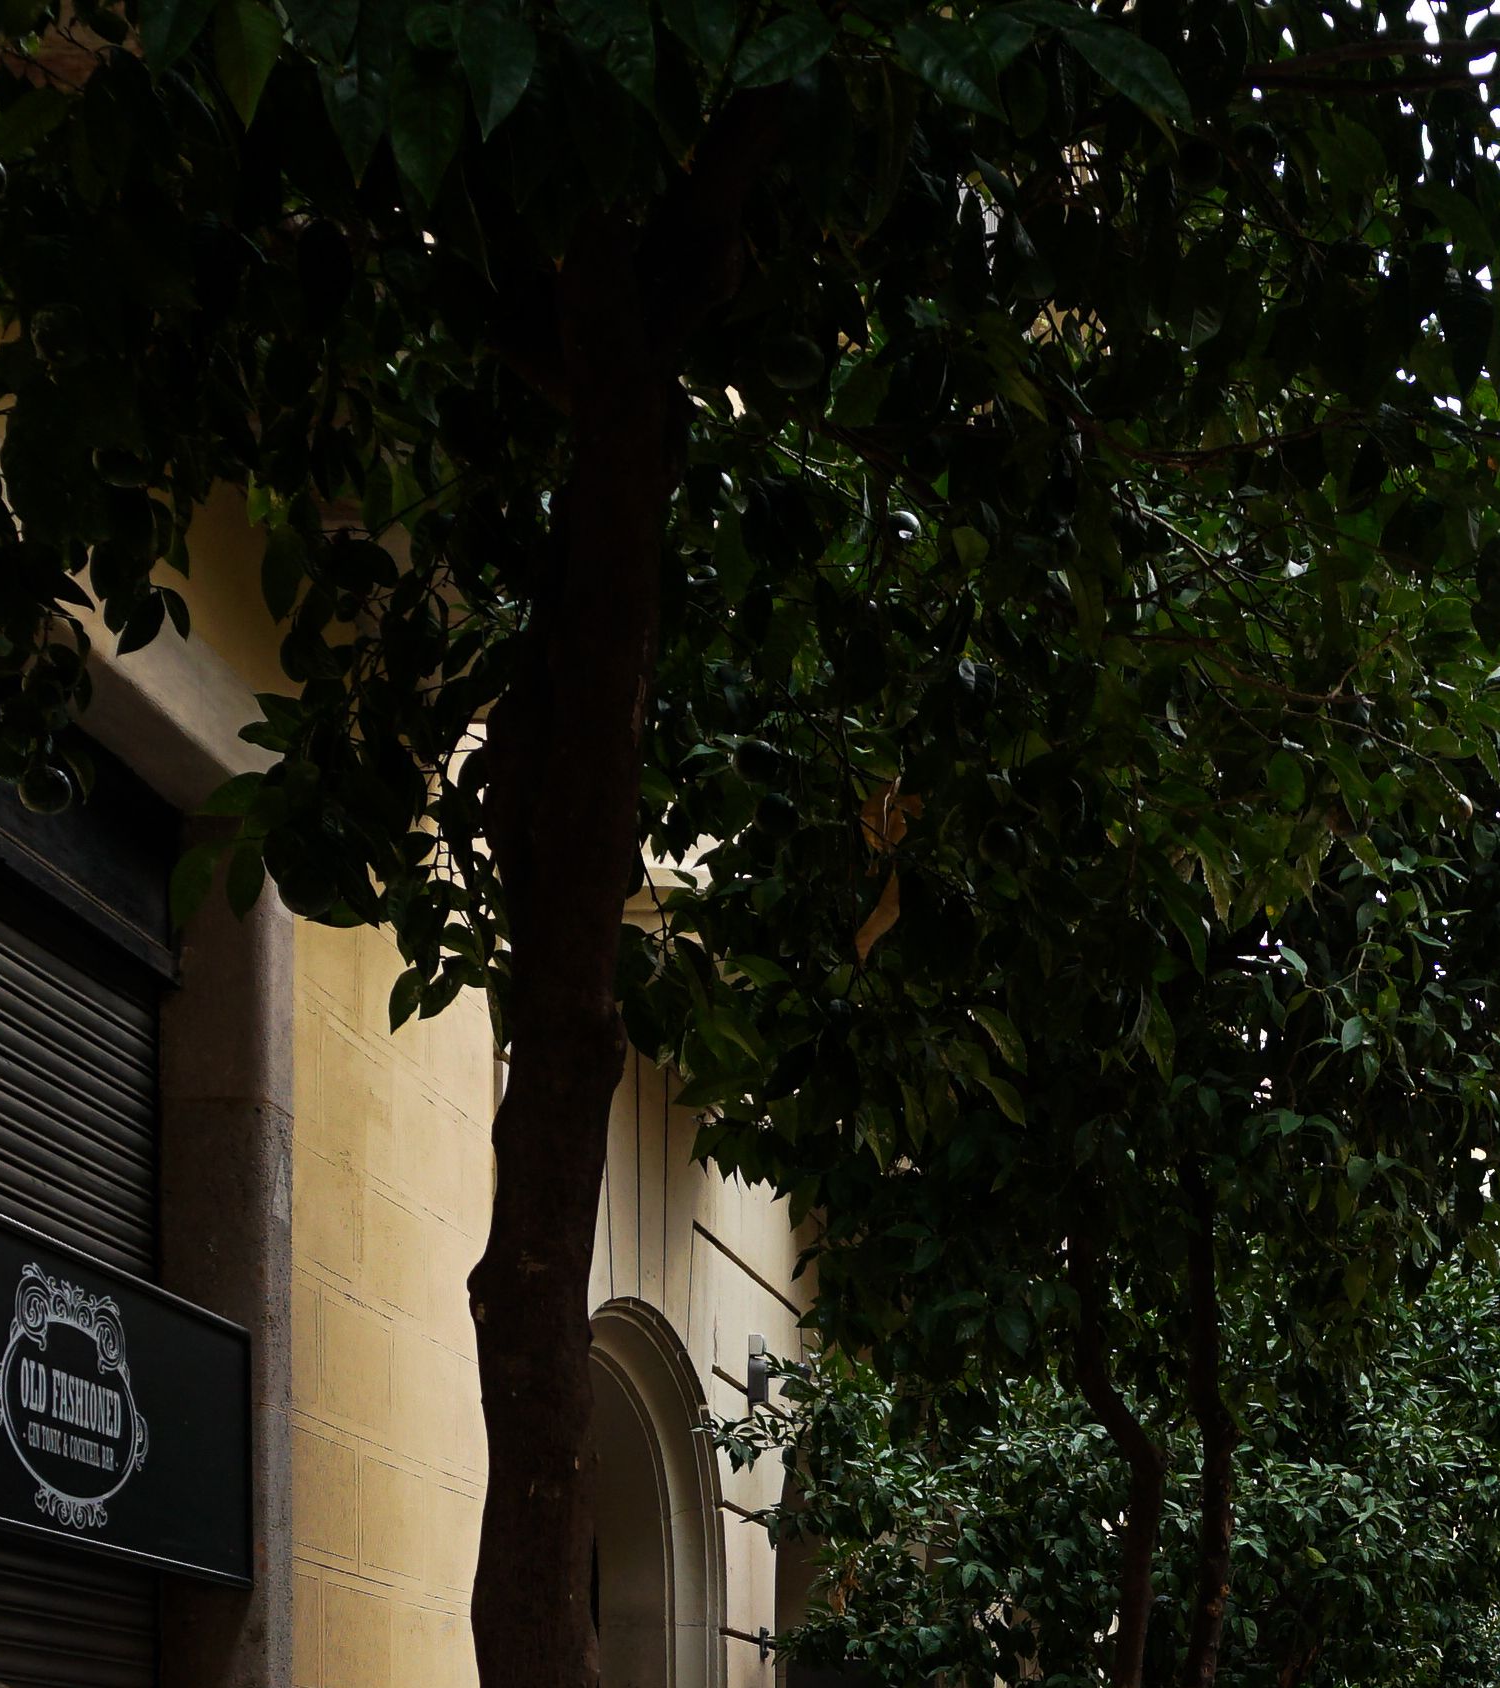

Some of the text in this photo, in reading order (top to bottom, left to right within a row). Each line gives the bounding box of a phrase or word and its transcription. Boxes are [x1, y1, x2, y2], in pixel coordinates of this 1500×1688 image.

[21, 1357, 121, 1438] OLD FASHIONED
[28, 1421, 114, 1471] GIN TONIC & COCKTAIL BAR
